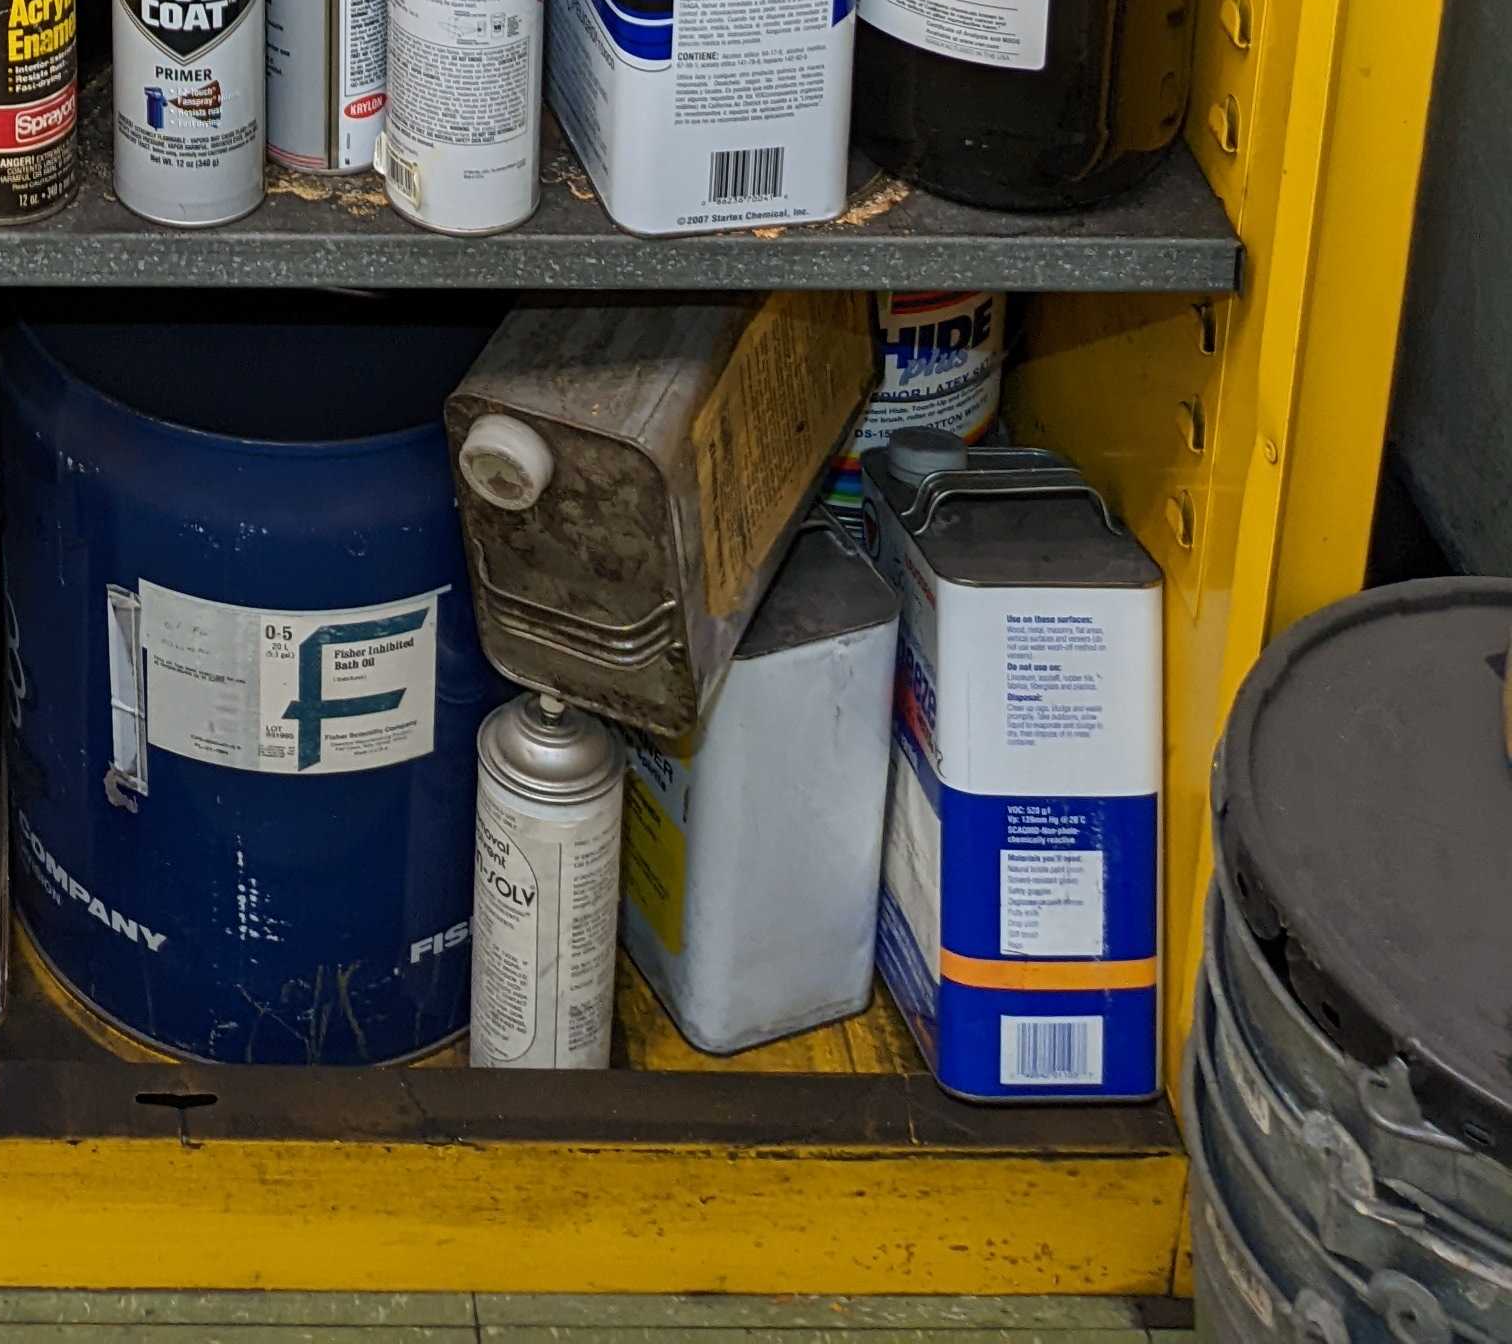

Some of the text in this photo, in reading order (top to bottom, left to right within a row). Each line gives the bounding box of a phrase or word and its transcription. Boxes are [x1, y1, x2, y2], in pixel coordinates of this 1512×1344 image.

[154, 64, 213, 83] PRIMER
[712, 213, 743, 223] Startex
[745, 210, 790, 220] Chemical,
[793, 207, 809, 216] Inc.
[334, 637, 414, 660] Fisher Inhibited
[334, 657, 376, 671] Bath Oil
[17, 807, 169, 954] COMPANY
